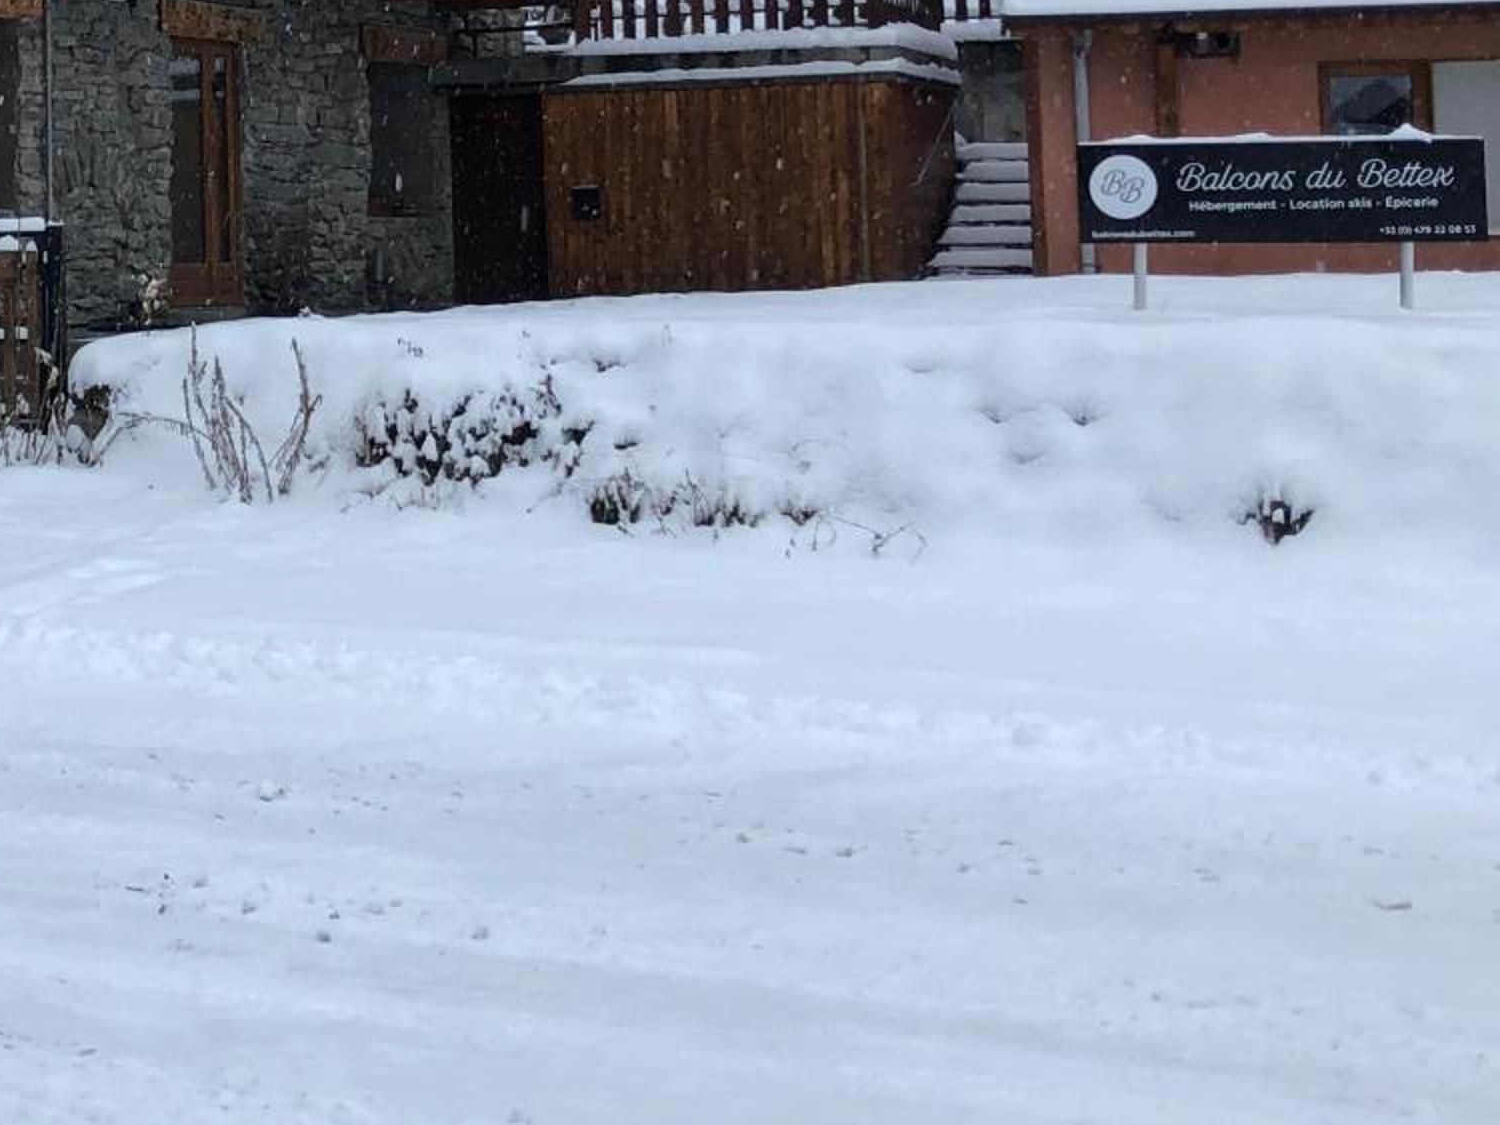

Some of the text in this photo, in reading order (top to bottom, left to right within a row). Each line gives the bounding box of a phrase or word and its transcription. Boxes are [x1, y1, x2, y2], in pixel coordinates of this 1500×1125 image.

[1176, 158, 1455, 192] Balcons du Bettex
[1188, 199, 1277, 213] Hébergement
[1289, 198, 1344, 210] Location
[1347, 197, 1373, 208] skis
[1385, 195, 1439, 209] Épicerie
